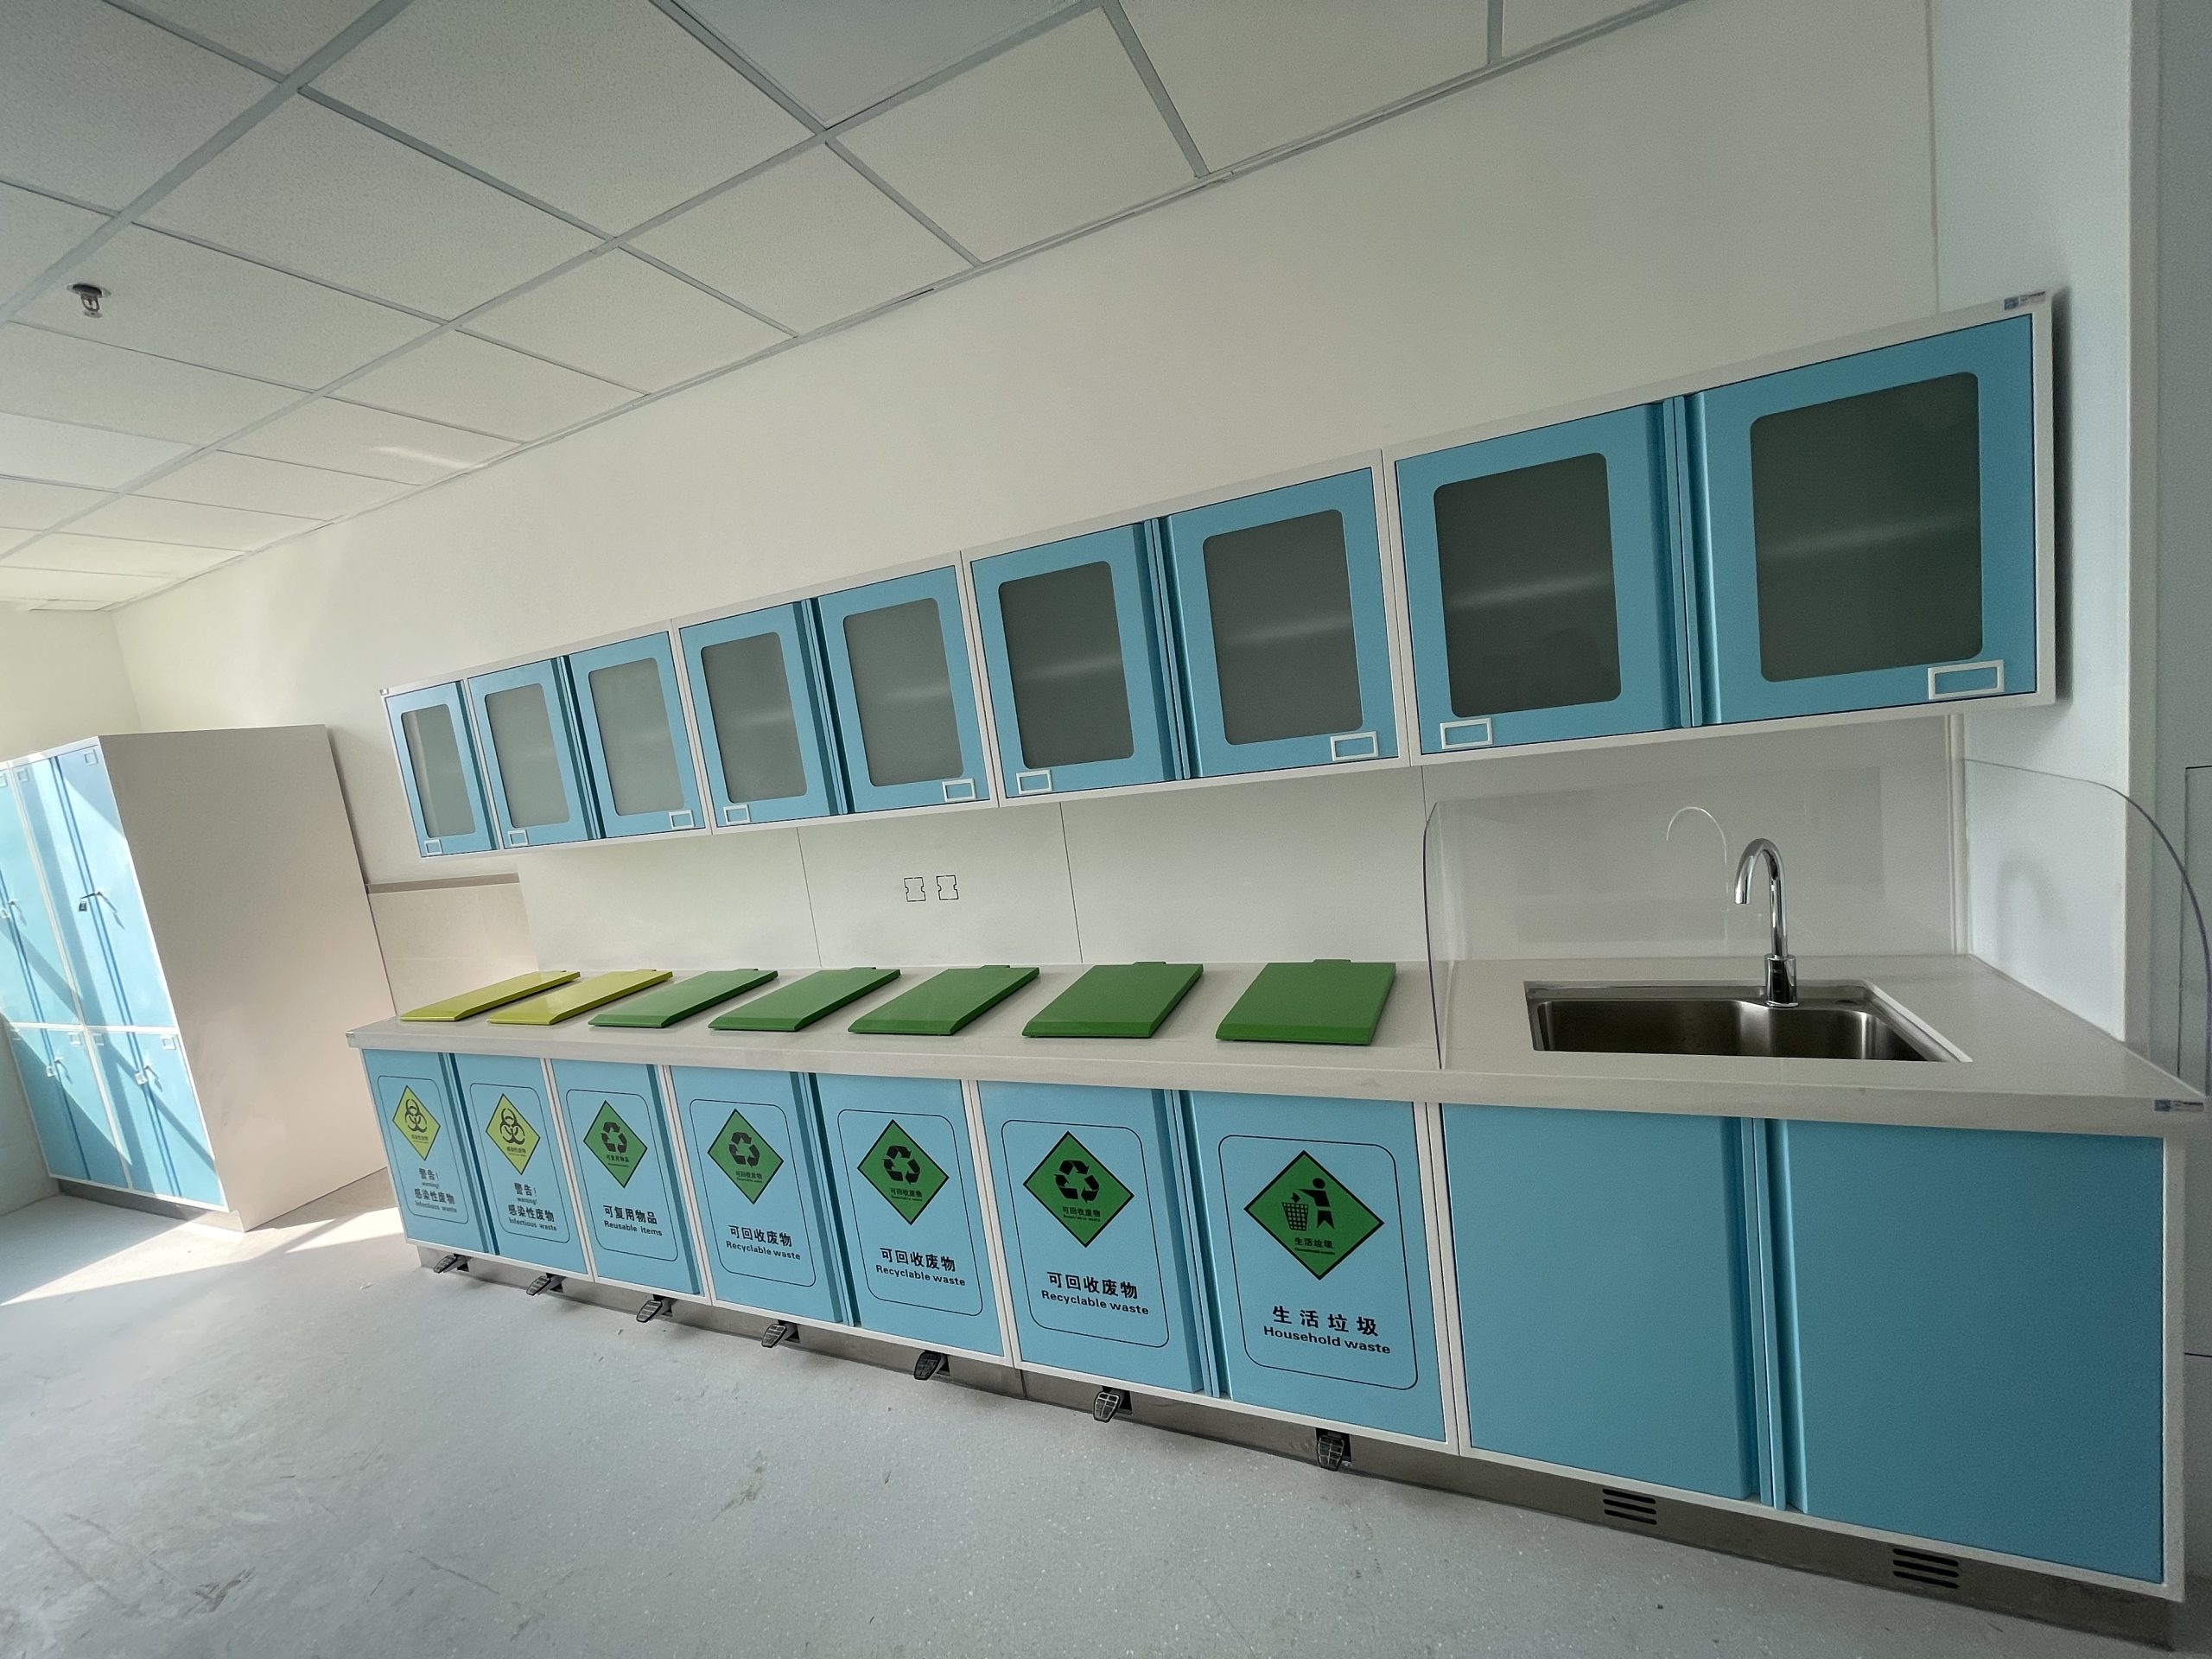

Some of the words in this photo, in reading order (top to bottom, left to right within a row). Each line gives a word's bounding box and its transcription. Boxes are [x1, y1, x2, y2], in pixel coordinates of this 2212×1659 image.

[508, 1204, 555, 1223] 感染性废物
[602, 1205, 658, 1225] 可复用物品
[603, 1219, 638, 1232] Reusable
[728, 1224, 792, 1248] 可回收废物
[725, 1240, 772, 1255] Recyclable
[772, 1249, 801, 1261] waste
[879, 1247, 956, 1273] 可回收废物
[875, 1264, 931, 1281] Recyclable
[932, 1274, 966, 1287] waste
[1046, 1271, 1138, 1300] 可回收废物
[1040, 1289, 1107, 1309] Recyclable
[1109, 1301, 1149, 1315] waste
[1272, 1305, 1379, 1337] 生活垃圾
[1263, 1325, 1342, 1347] Household
[1344, 1339, 1391, 1354] waste
